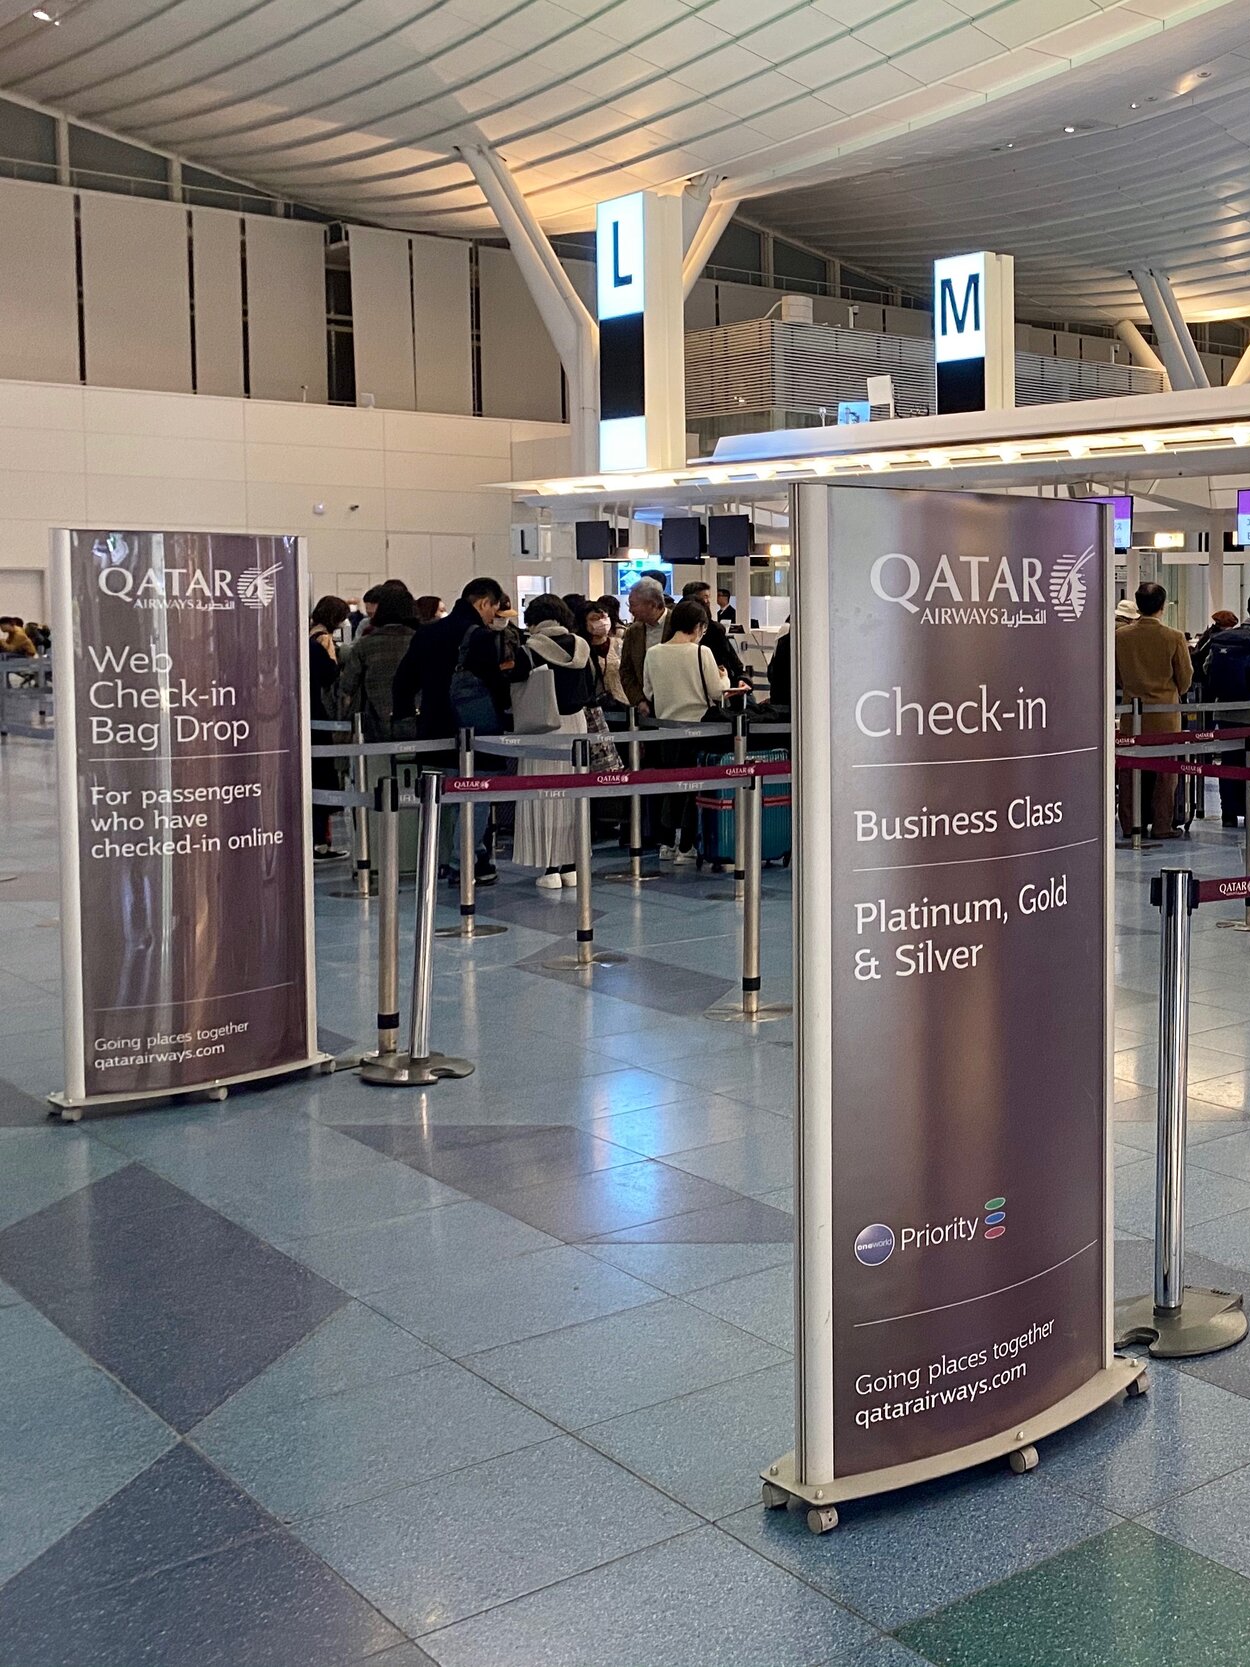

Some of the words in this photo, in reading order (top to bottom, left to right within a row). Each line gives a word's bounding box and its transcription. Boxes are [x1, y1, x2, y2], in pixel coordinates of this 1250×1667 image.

[613, 221, 632, 288] L
[940, 273, 980, 336] M
[520, 529, 529, 555] L
[98, 567, 234, 602] QATAR
[870, 553, 1046, 614] QATAR
[133, 599, 195, 609] AIRWAYS
[920, 607, 998, 625] AIRWAYS
[1000, 608, 1047, 628] القطرية
[88, 644, 173, 673] Web
[89, 679, 236, 708] Check-in
[855, 684, 1046, 737] Check-in
[89, 716, 159, 750] Bag
[174, 715, 250, 746] Drop
[454, 780, 480, 789] QATAR
[597, 775, 621, 783] QATAR
[726, 768, 747, 776] QATAR
[90, 787, 132, 805] For
[142, 783, 262, 809] passengers
[91, 812, 144, 832] who
[154, 810, 208, 829] have
[854, 806, 998, 841] Business
[1007, 796, 1063, 830] Class
[91, 834, 221, 858] checked-in
[228, 828, 283, 849] online
[1219, 881, 1247, 894] QATAR
[854, 897, 1008, 935] Platinum,
[1018, 874, 1068, 915] Gold
[854, 948, 881, 981] &
[895, 940, 983, 977] Silver
[95, 1037, 141, 1051] Going
[147, 1033, 192, 1049] places
[197, 1021, 249, 1040] together
[94, 1043, 225, 1071] qatarairways.com
[857, 1239, 892, 1251] oneworld
[901, 1216, 979, 1250] Priority
[855, 1366, 920, 1395] Going
[929, 1349, 987, 1384] places
[993, 1318, 1055, 1360] together
[855, 1362, 1027, 1429] qatarairways.com
